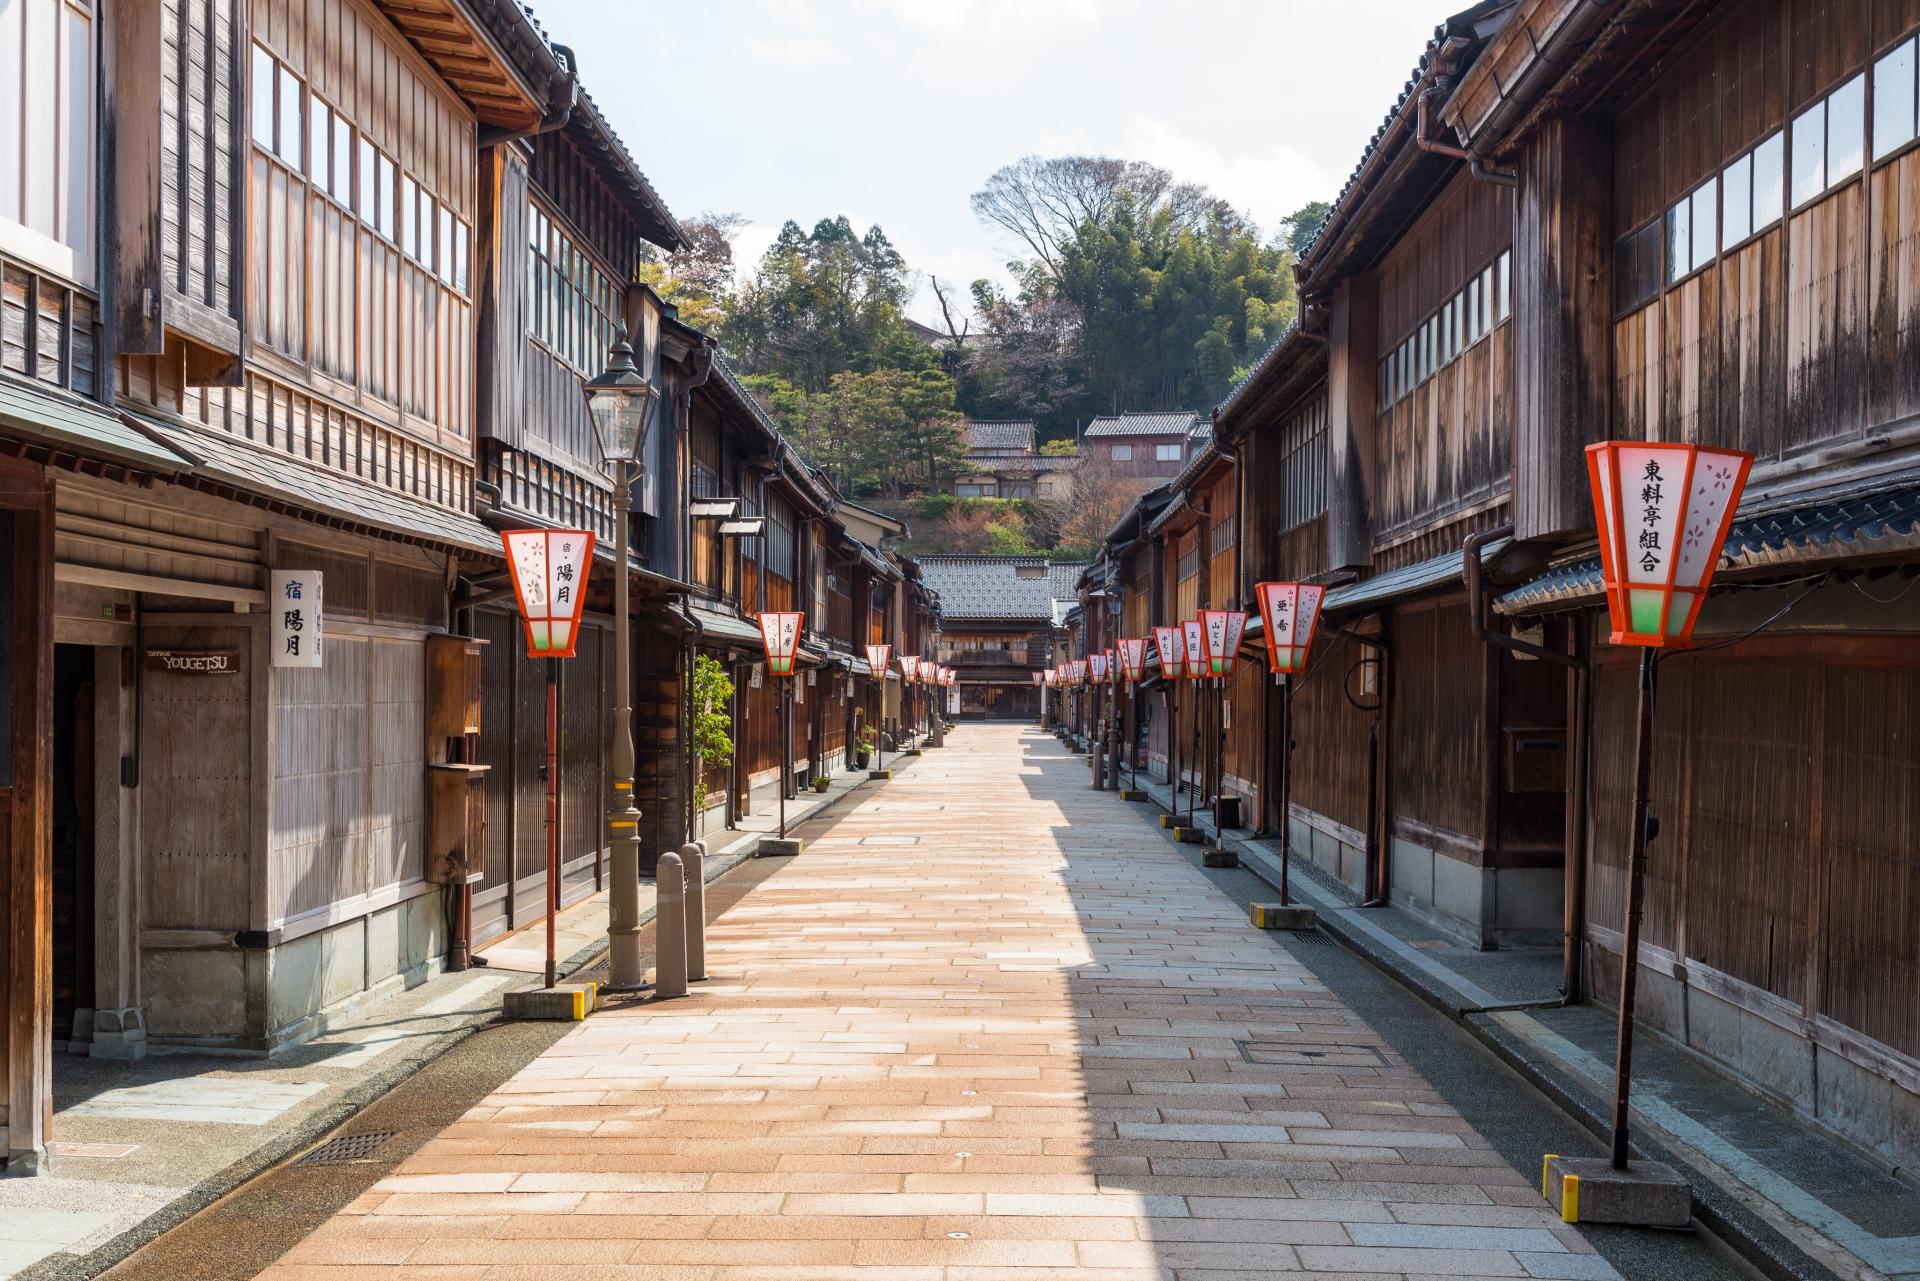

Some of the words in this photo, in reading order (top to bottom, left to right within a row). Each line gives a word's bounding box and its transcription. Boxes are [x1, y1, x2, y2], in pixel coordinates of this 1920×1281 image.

[1639, 459, 1664, 573] 東料亭組合
[1276, 600, 1289, 632] 亜希
[1212, 622, 1220, 647] 山とみ
[163, 656, 227, 670] YOUGETSU
